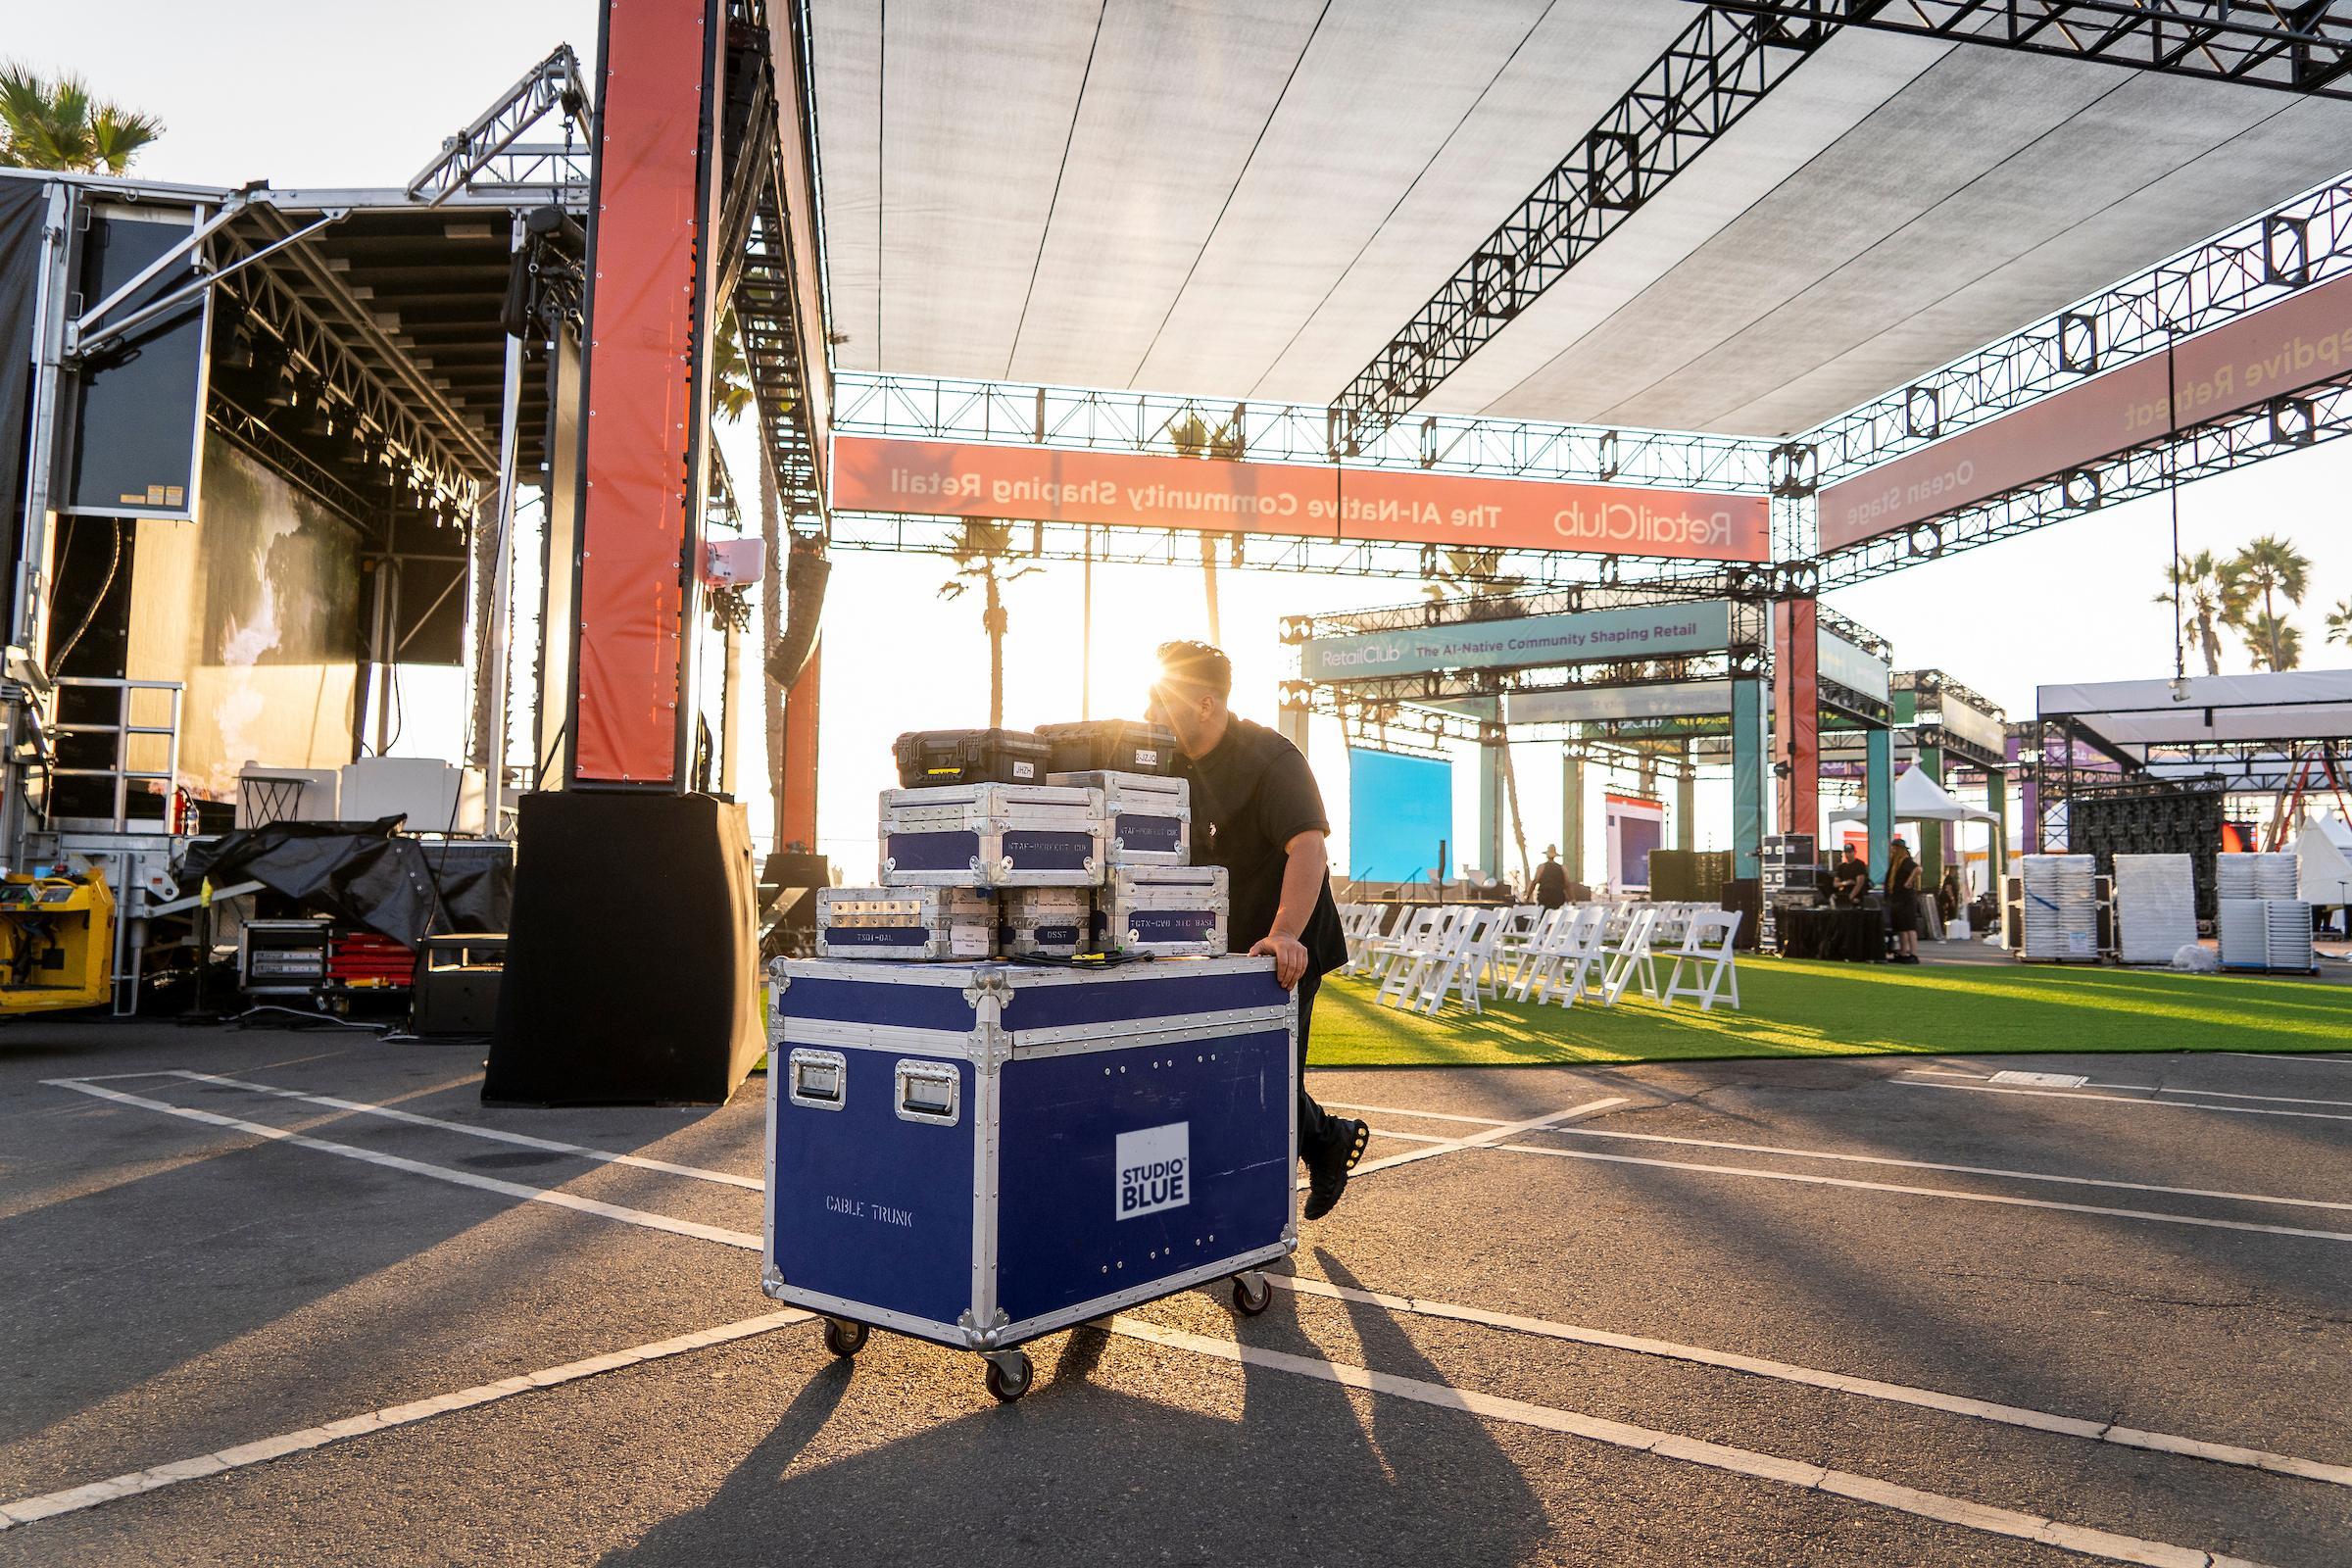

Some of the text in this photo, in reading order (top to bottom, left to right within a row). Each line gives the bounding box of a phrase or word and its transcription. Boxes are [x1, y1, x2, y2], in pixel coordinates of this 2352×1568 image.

[1322, 622, 1696, 668] RetailClub The AI-Native Community Shaping Retail
[1175, 919, 1191, 928] MIC
[1195, 918, 1214, 928] BASE
[1123, 1175, 1184, 1212] BLUE
[826, 1195, 913, 1228] CABLE TRUNK
